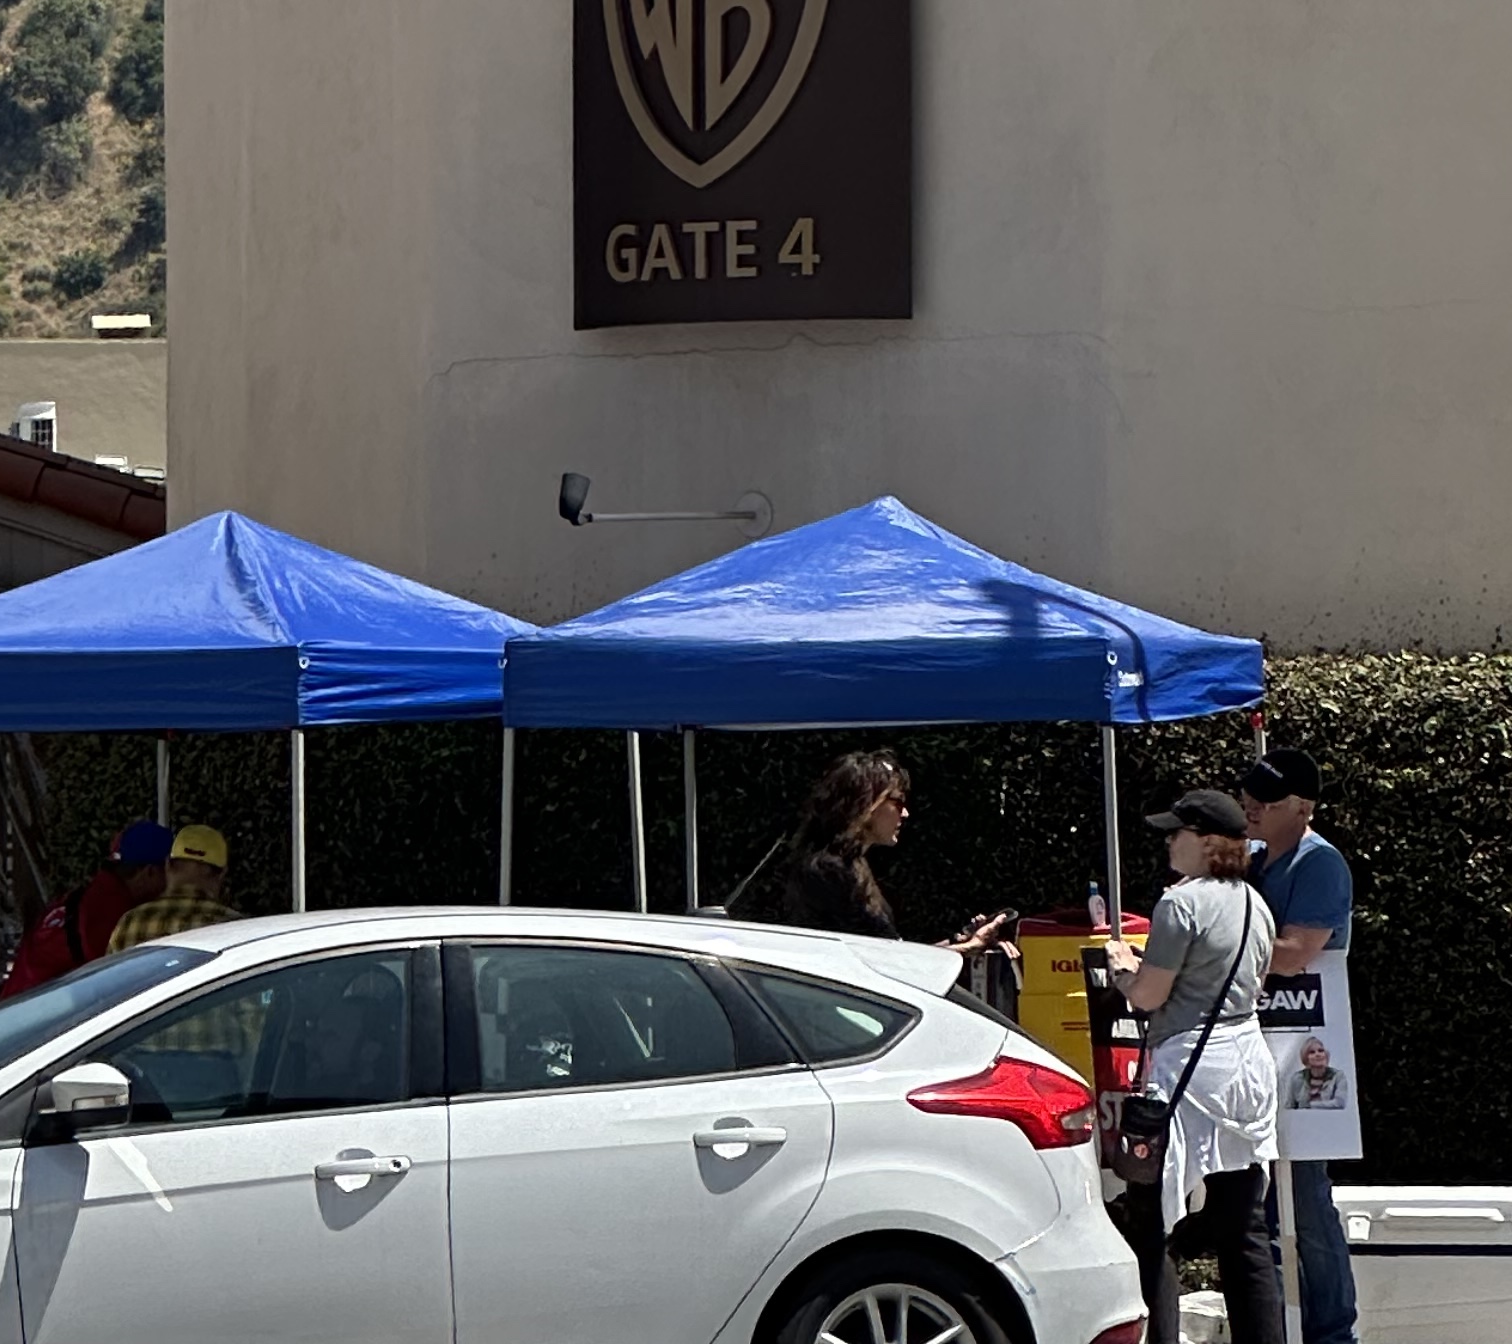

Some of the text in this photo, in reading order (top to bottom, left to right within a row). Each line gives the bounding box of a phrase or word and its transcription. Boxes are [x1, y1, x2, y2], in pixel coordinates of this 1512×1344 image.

[605, 217, 821, 283] GATE 4
[1254, 990, 1318, 1010] GAW
